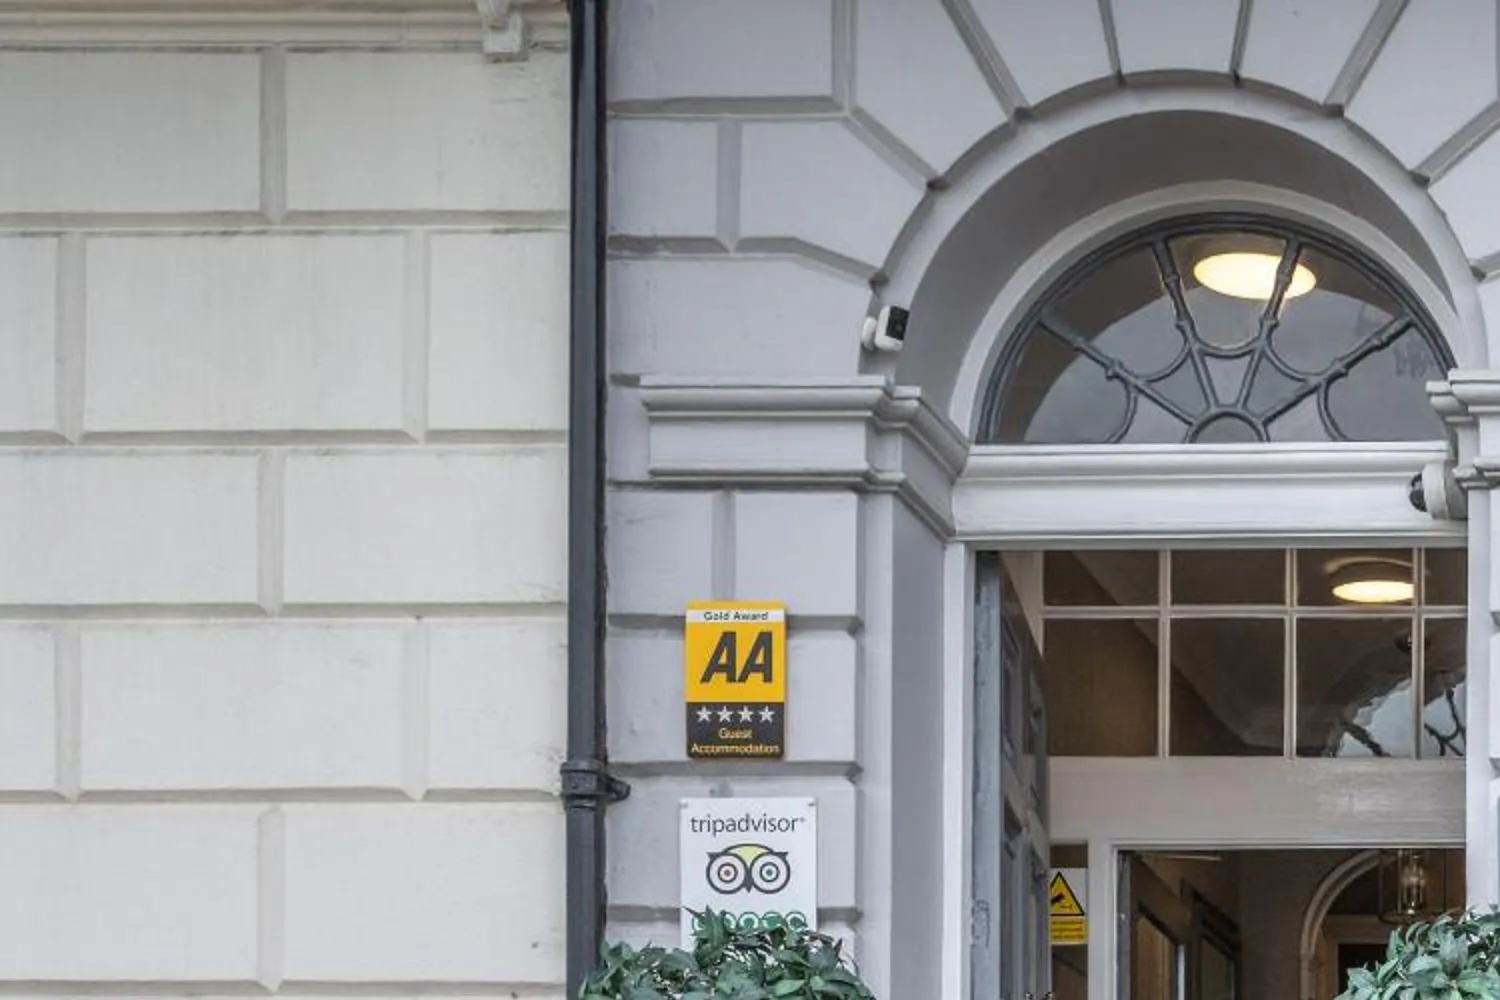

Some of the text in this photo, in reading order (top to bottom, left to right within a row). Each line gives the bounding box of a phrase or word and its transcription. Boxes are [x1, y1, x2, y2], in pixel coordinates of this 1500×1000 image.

[703, 611, 769, 621] Gold Award
[701, 631, 773, 684] AA
[719, 727, 753, 739] Guest
[691, 742, 780, 753] Accommodation
[690, 812, 799, 838] tripadvisor
